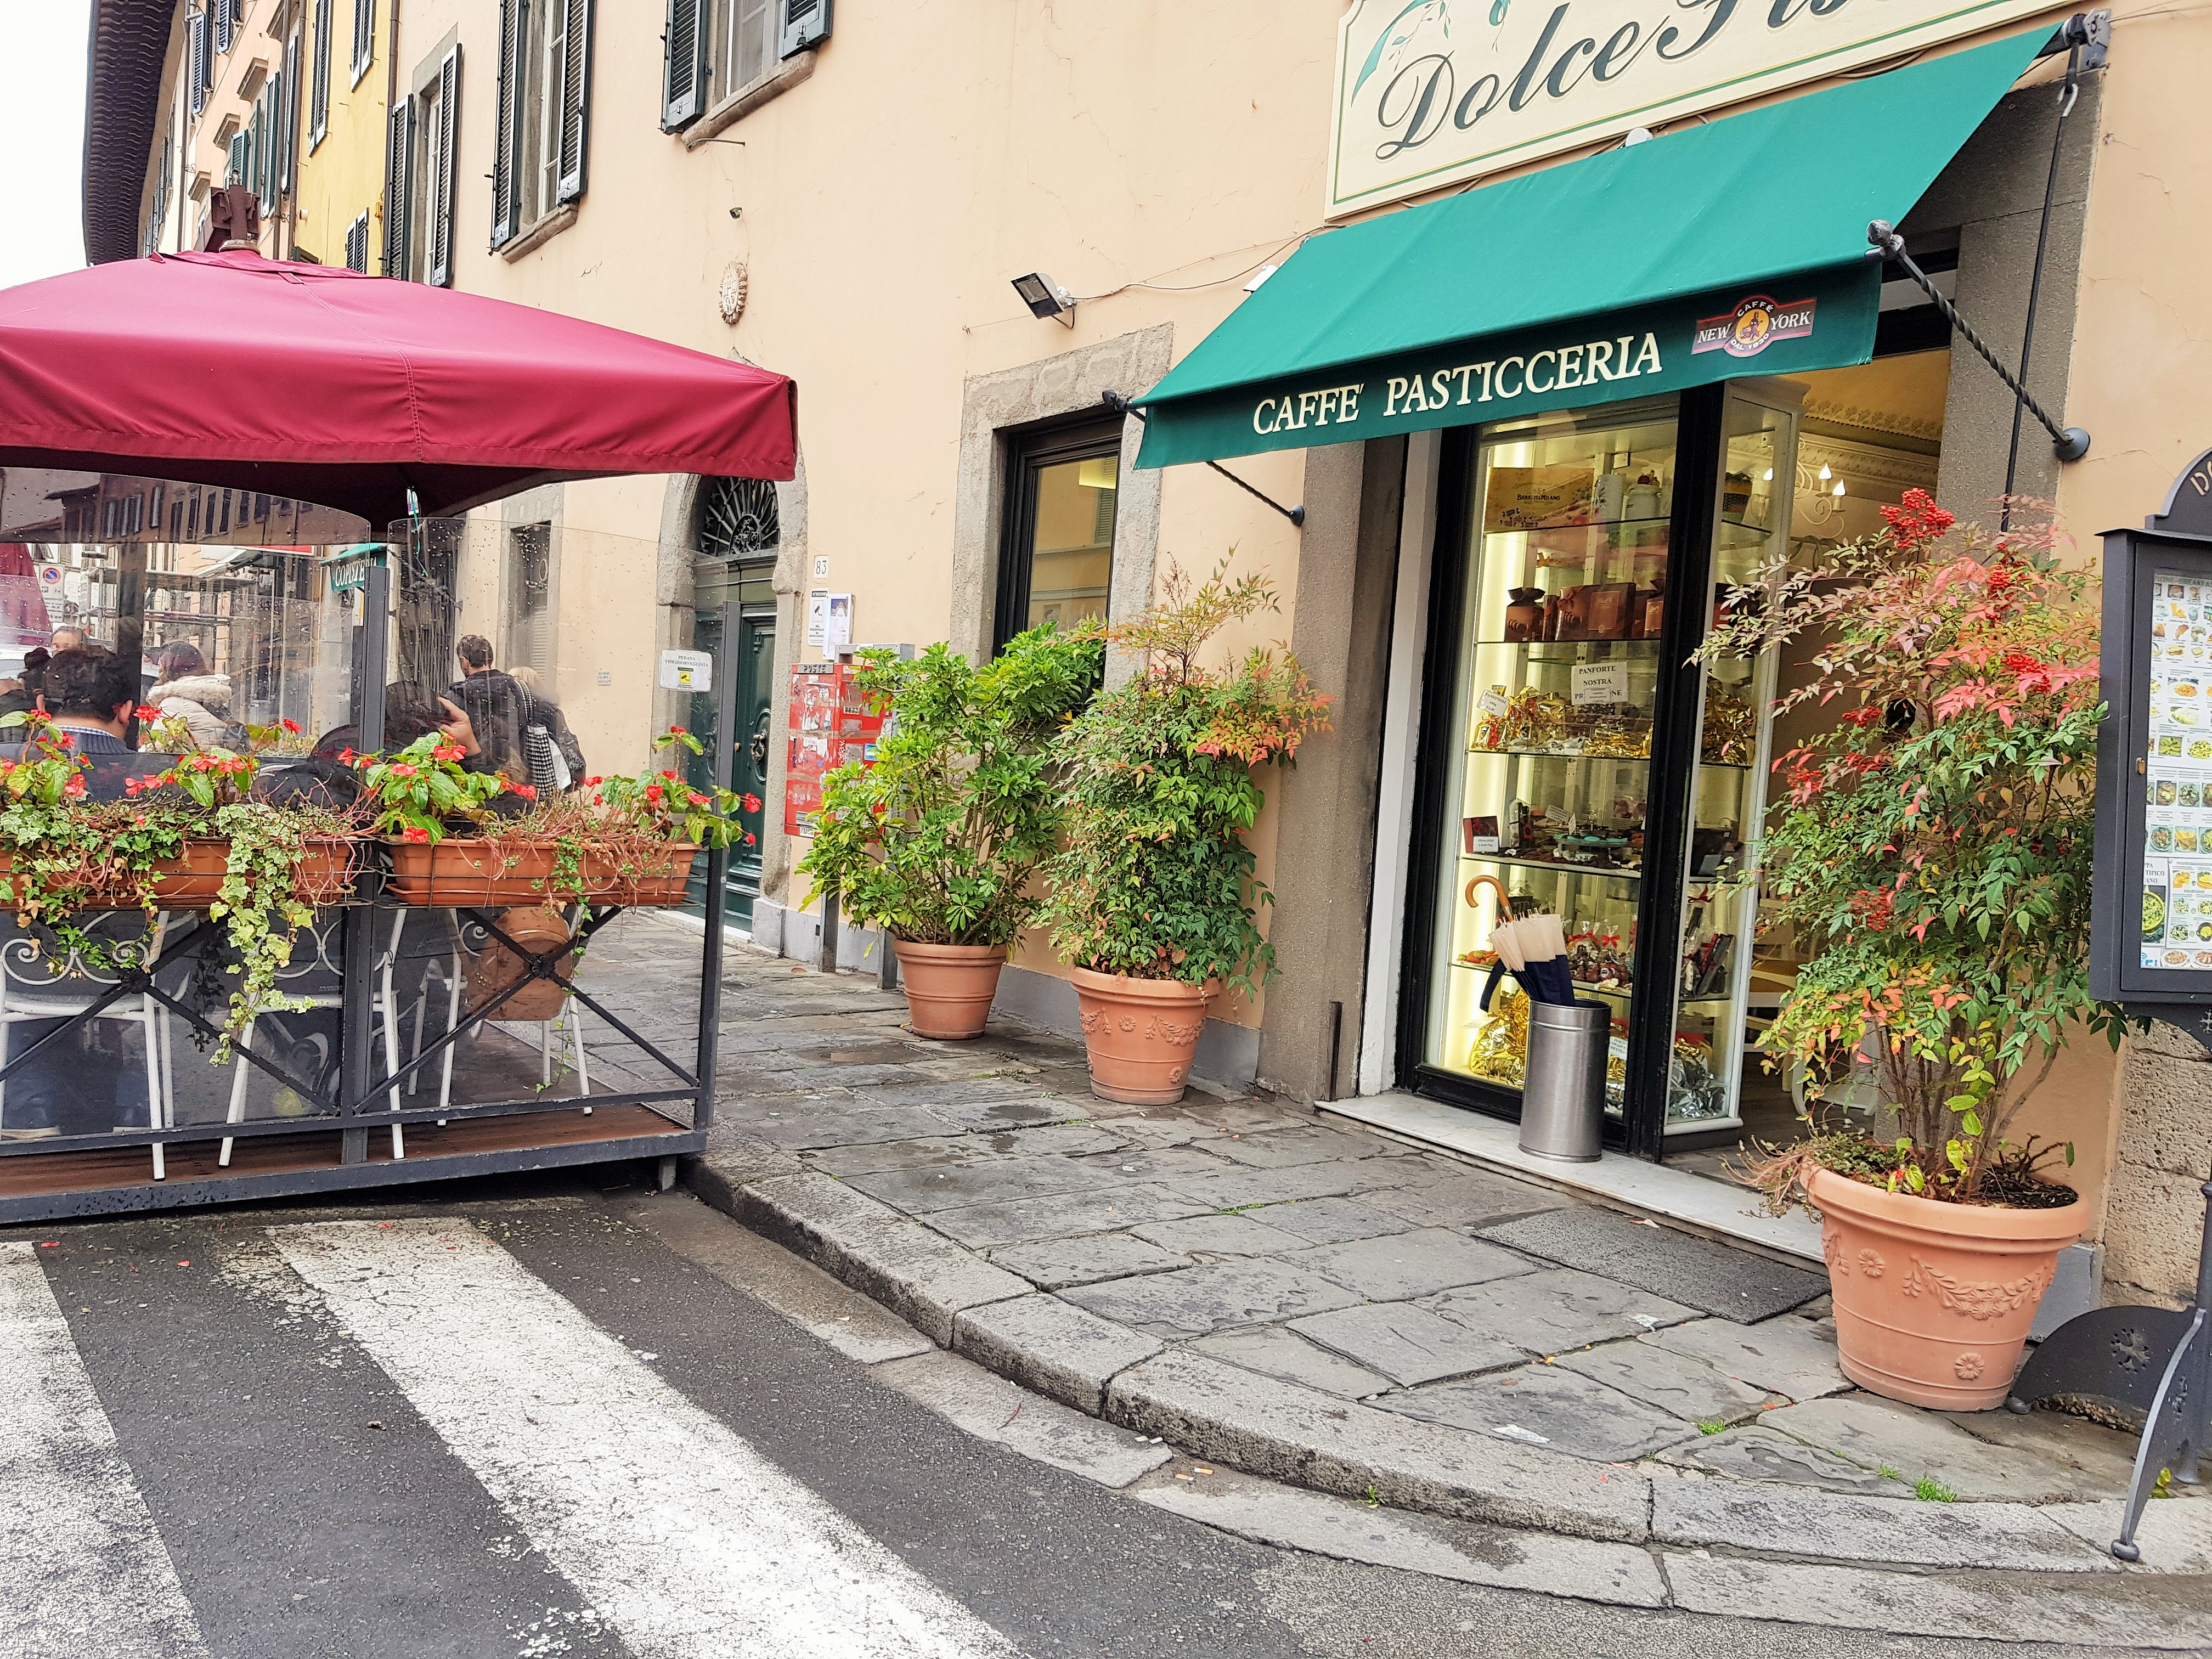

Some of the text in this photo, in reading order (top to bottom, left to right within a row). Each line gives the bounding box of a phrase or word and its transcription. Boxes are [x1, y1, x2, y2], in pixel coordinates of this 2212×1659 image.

[1376, 2, 1669, 160] Dolce
[1697, 311, 1811, 344] NEW YORK
[1730, 333, 1769, 351] DAL 1930
[1383, 332, 1663, 417] PASTICCERIA
[816, 560, 827, 575] 83
[804, 664, 826, 673] POSTE
[1579, 665, 1616, 675] PANFORTE
[1583, 678, 1612, 686] NOSTRA
